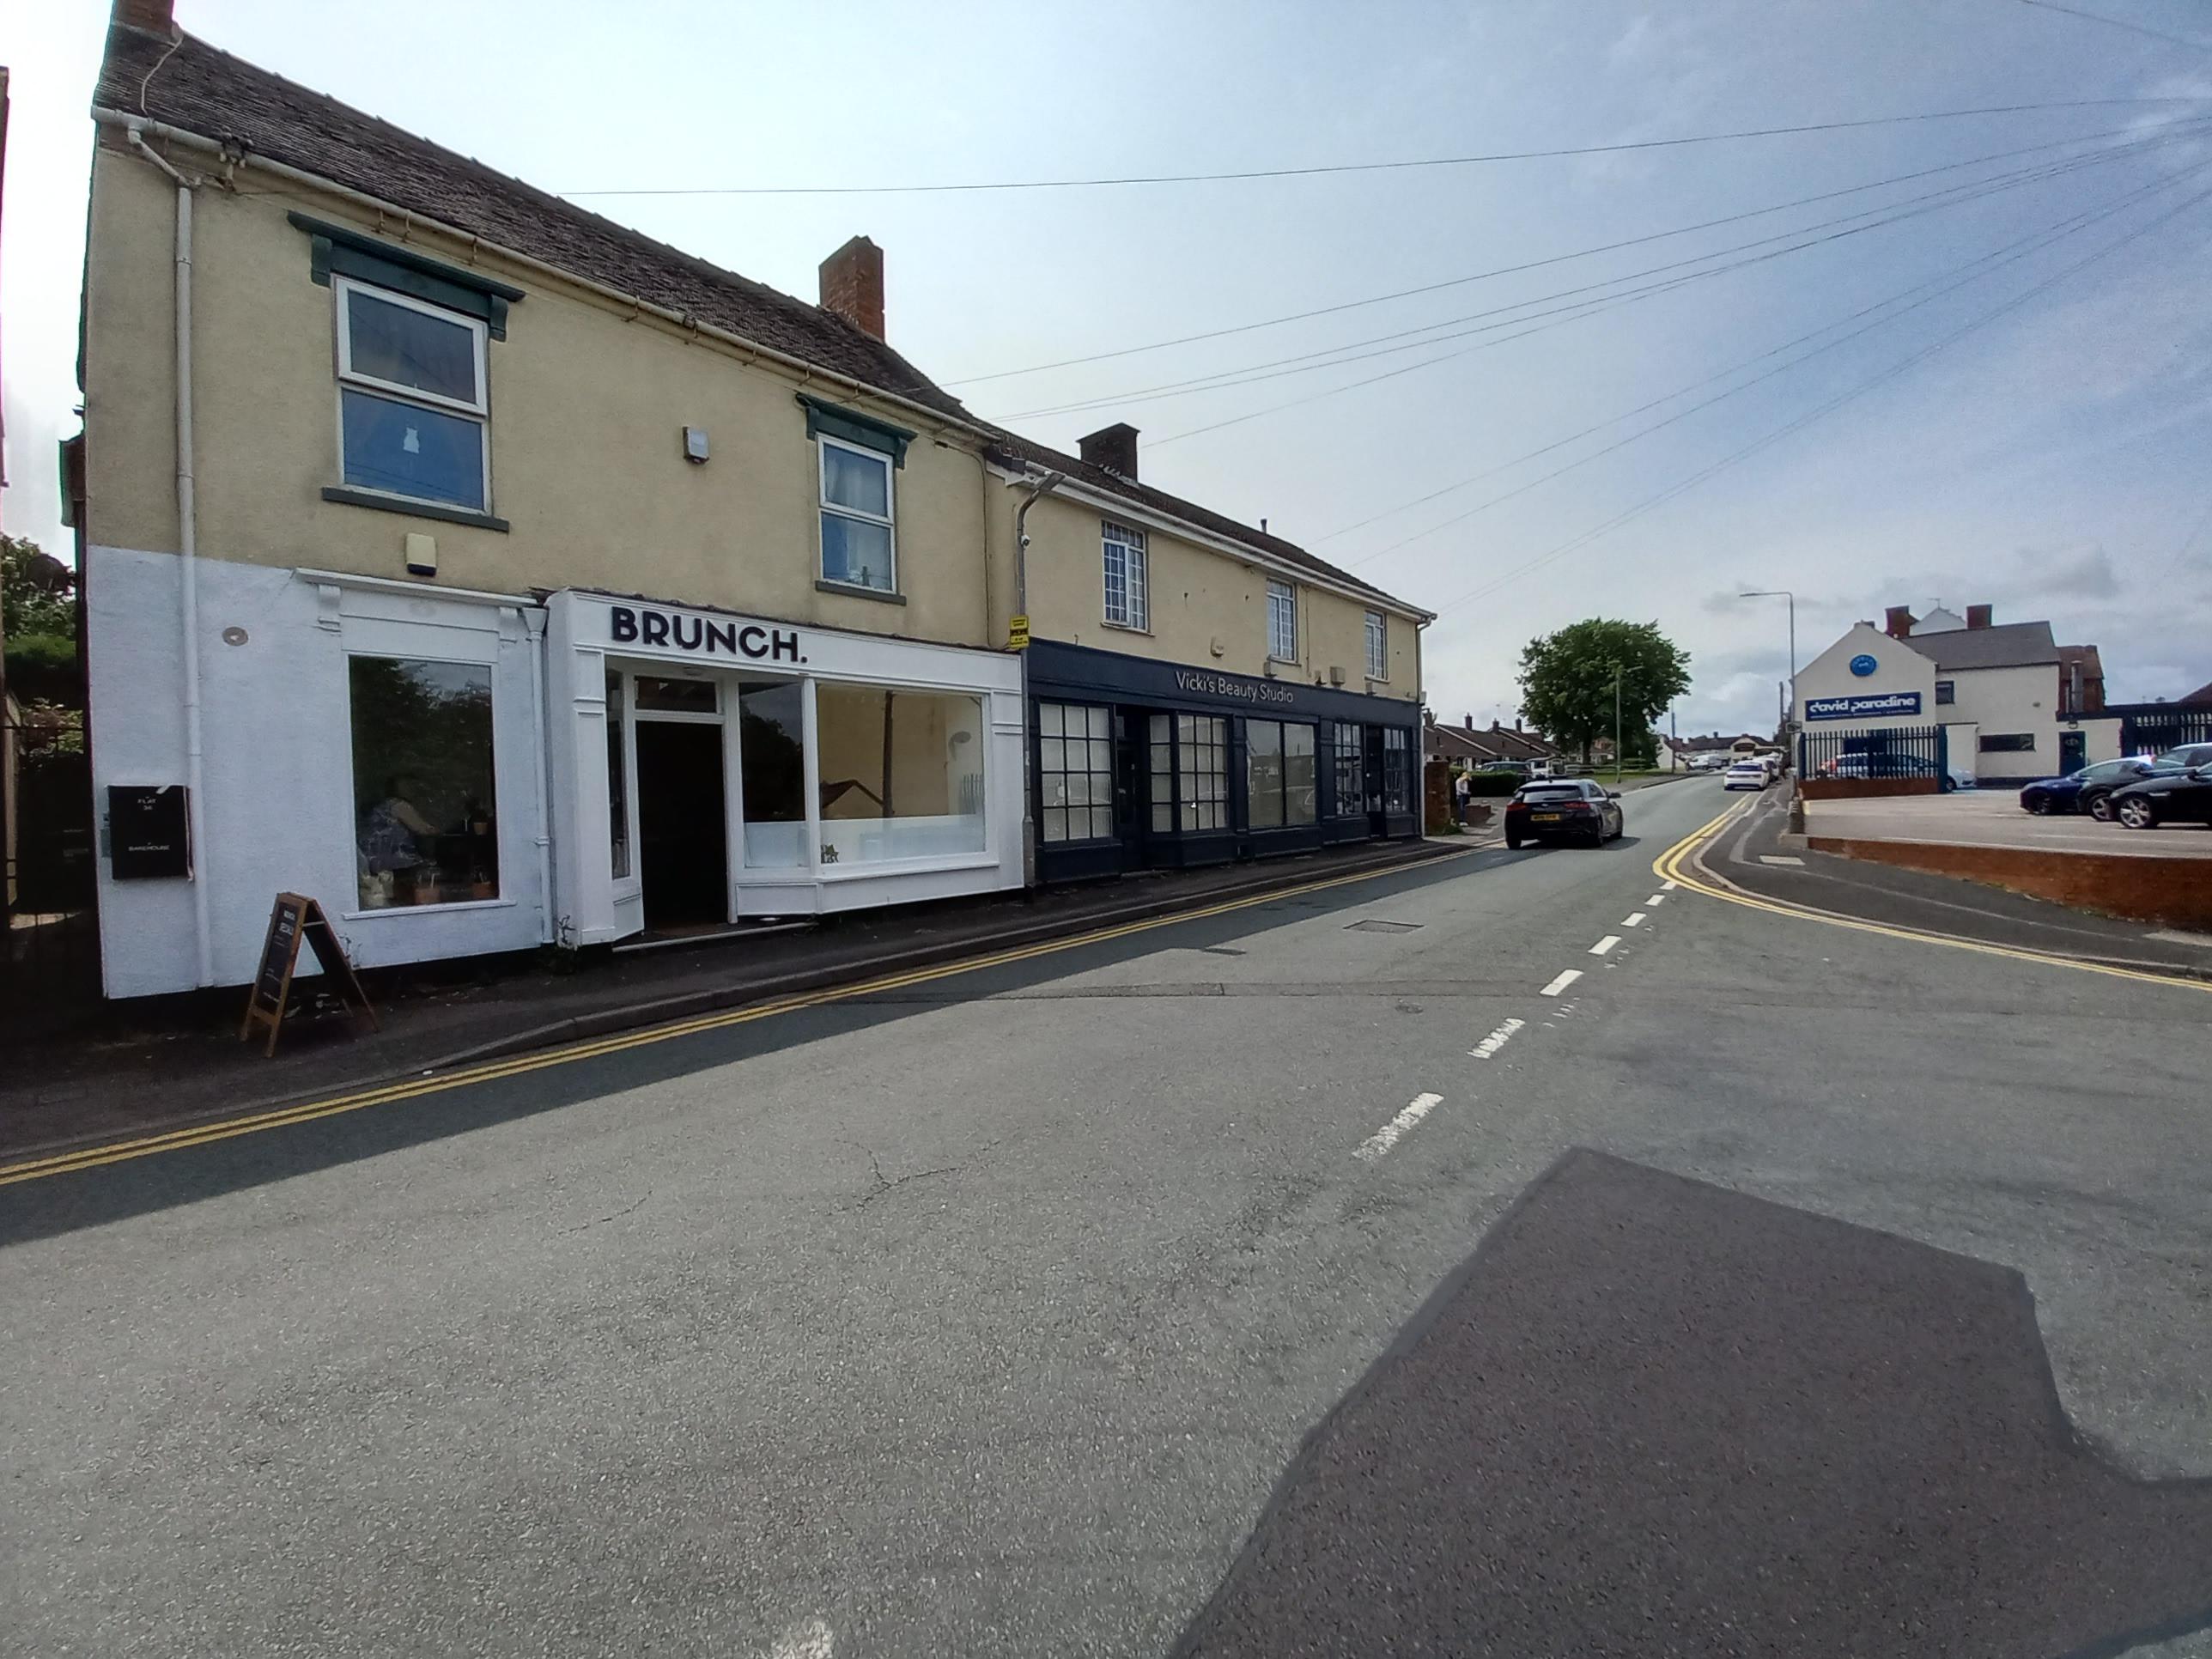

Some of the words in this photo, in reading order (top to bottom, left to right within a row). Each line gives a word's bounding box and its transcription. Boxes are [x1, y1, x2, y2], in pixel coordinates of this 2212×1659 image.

[611, 606, 808, 664] BRUNCH.
[1176, 671, 1215, 694] Vicki's
[1218, 678, 1258, 703] Beauty
[1260, 684, 1294, 703] Studio
[1809, 699, 1849, 713] david
[1850, 696, 1916, 712] paradine
